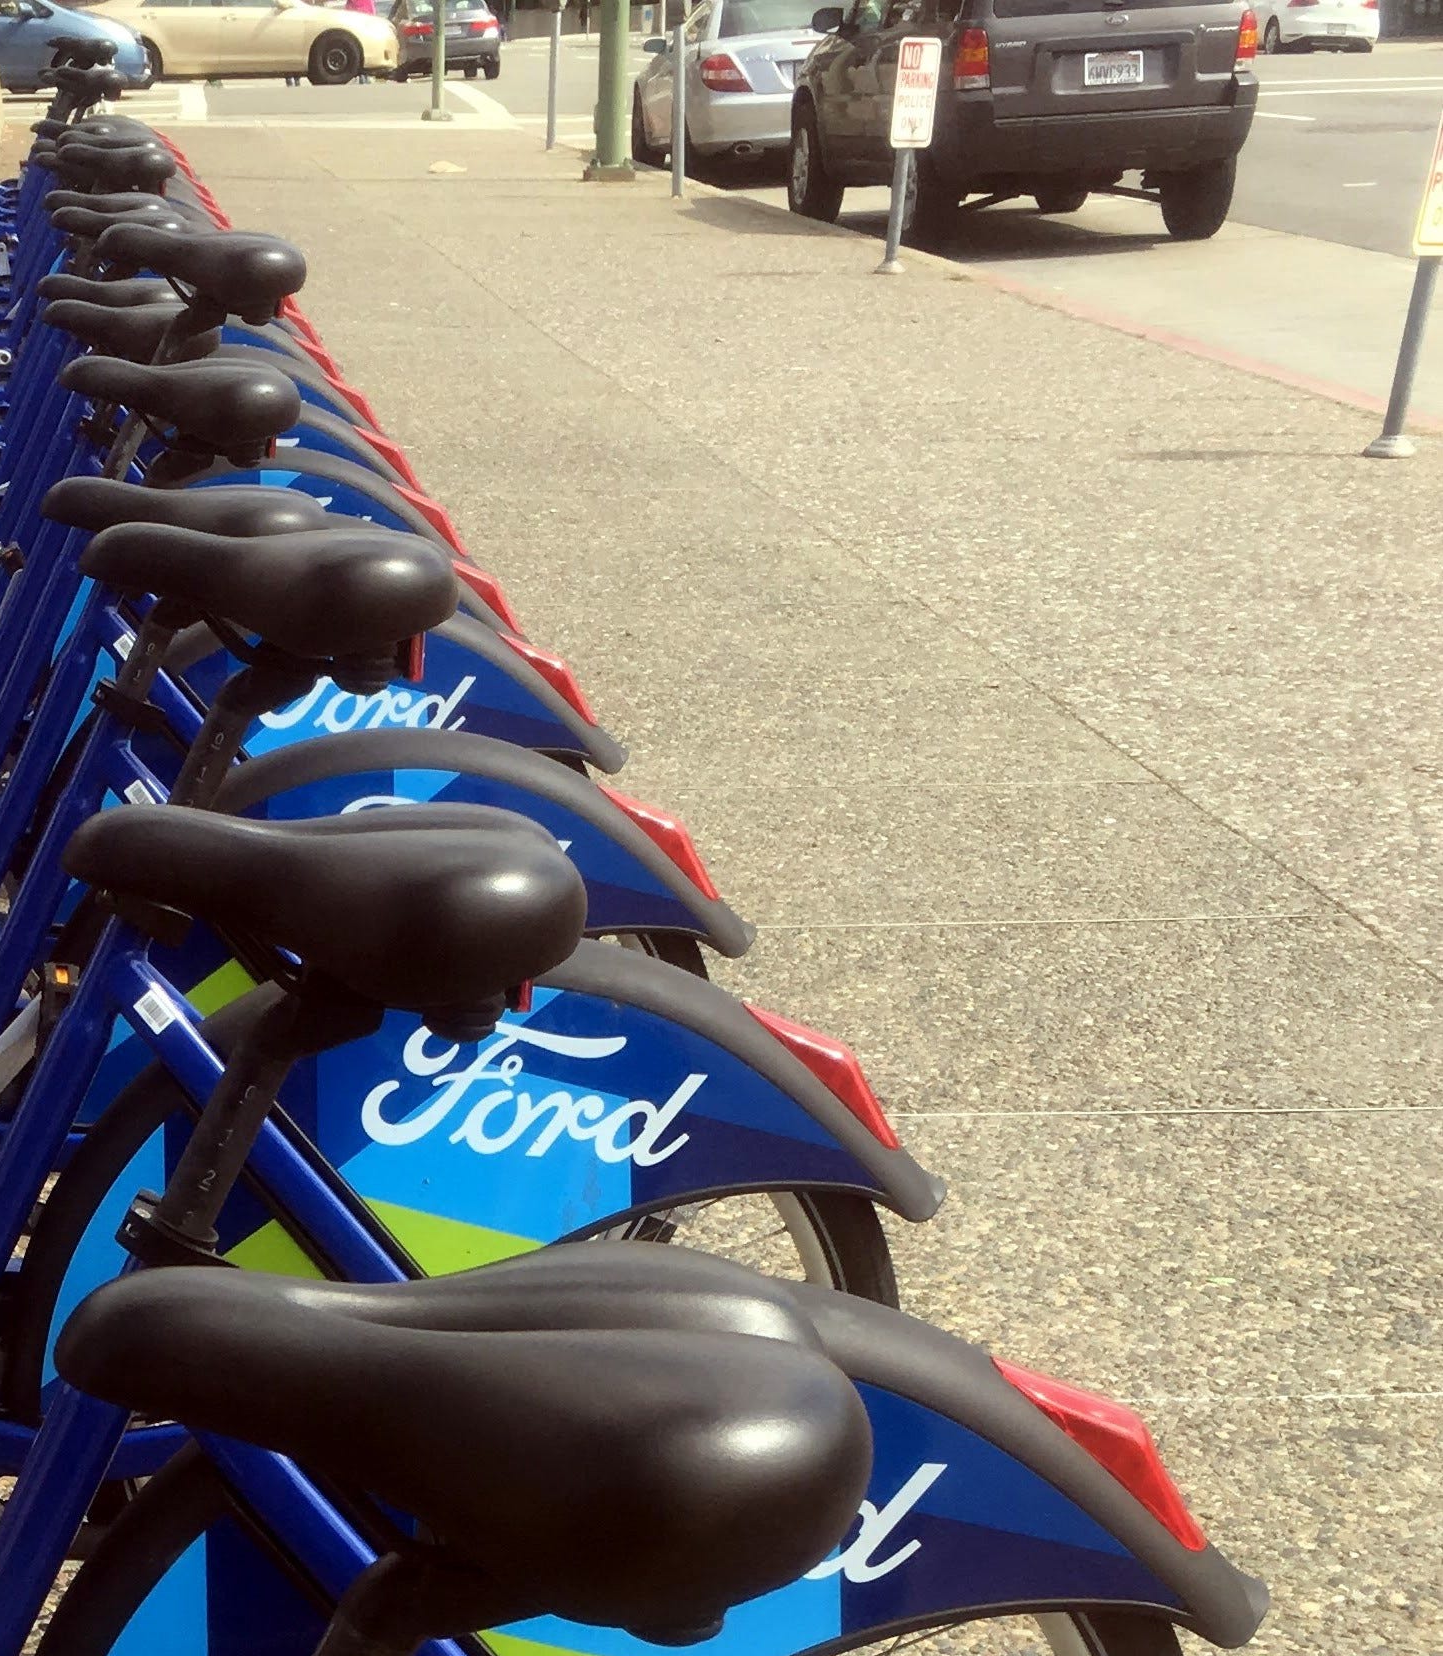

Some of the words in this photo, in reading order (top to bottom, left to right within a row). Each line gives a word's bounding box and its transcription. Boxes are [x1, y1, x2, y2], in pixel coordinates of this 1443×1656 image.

[902, 44, 921, 69] NO
[900, 72, 935, 88] PARKING
[361, 1020, 708, 1167] Ford
